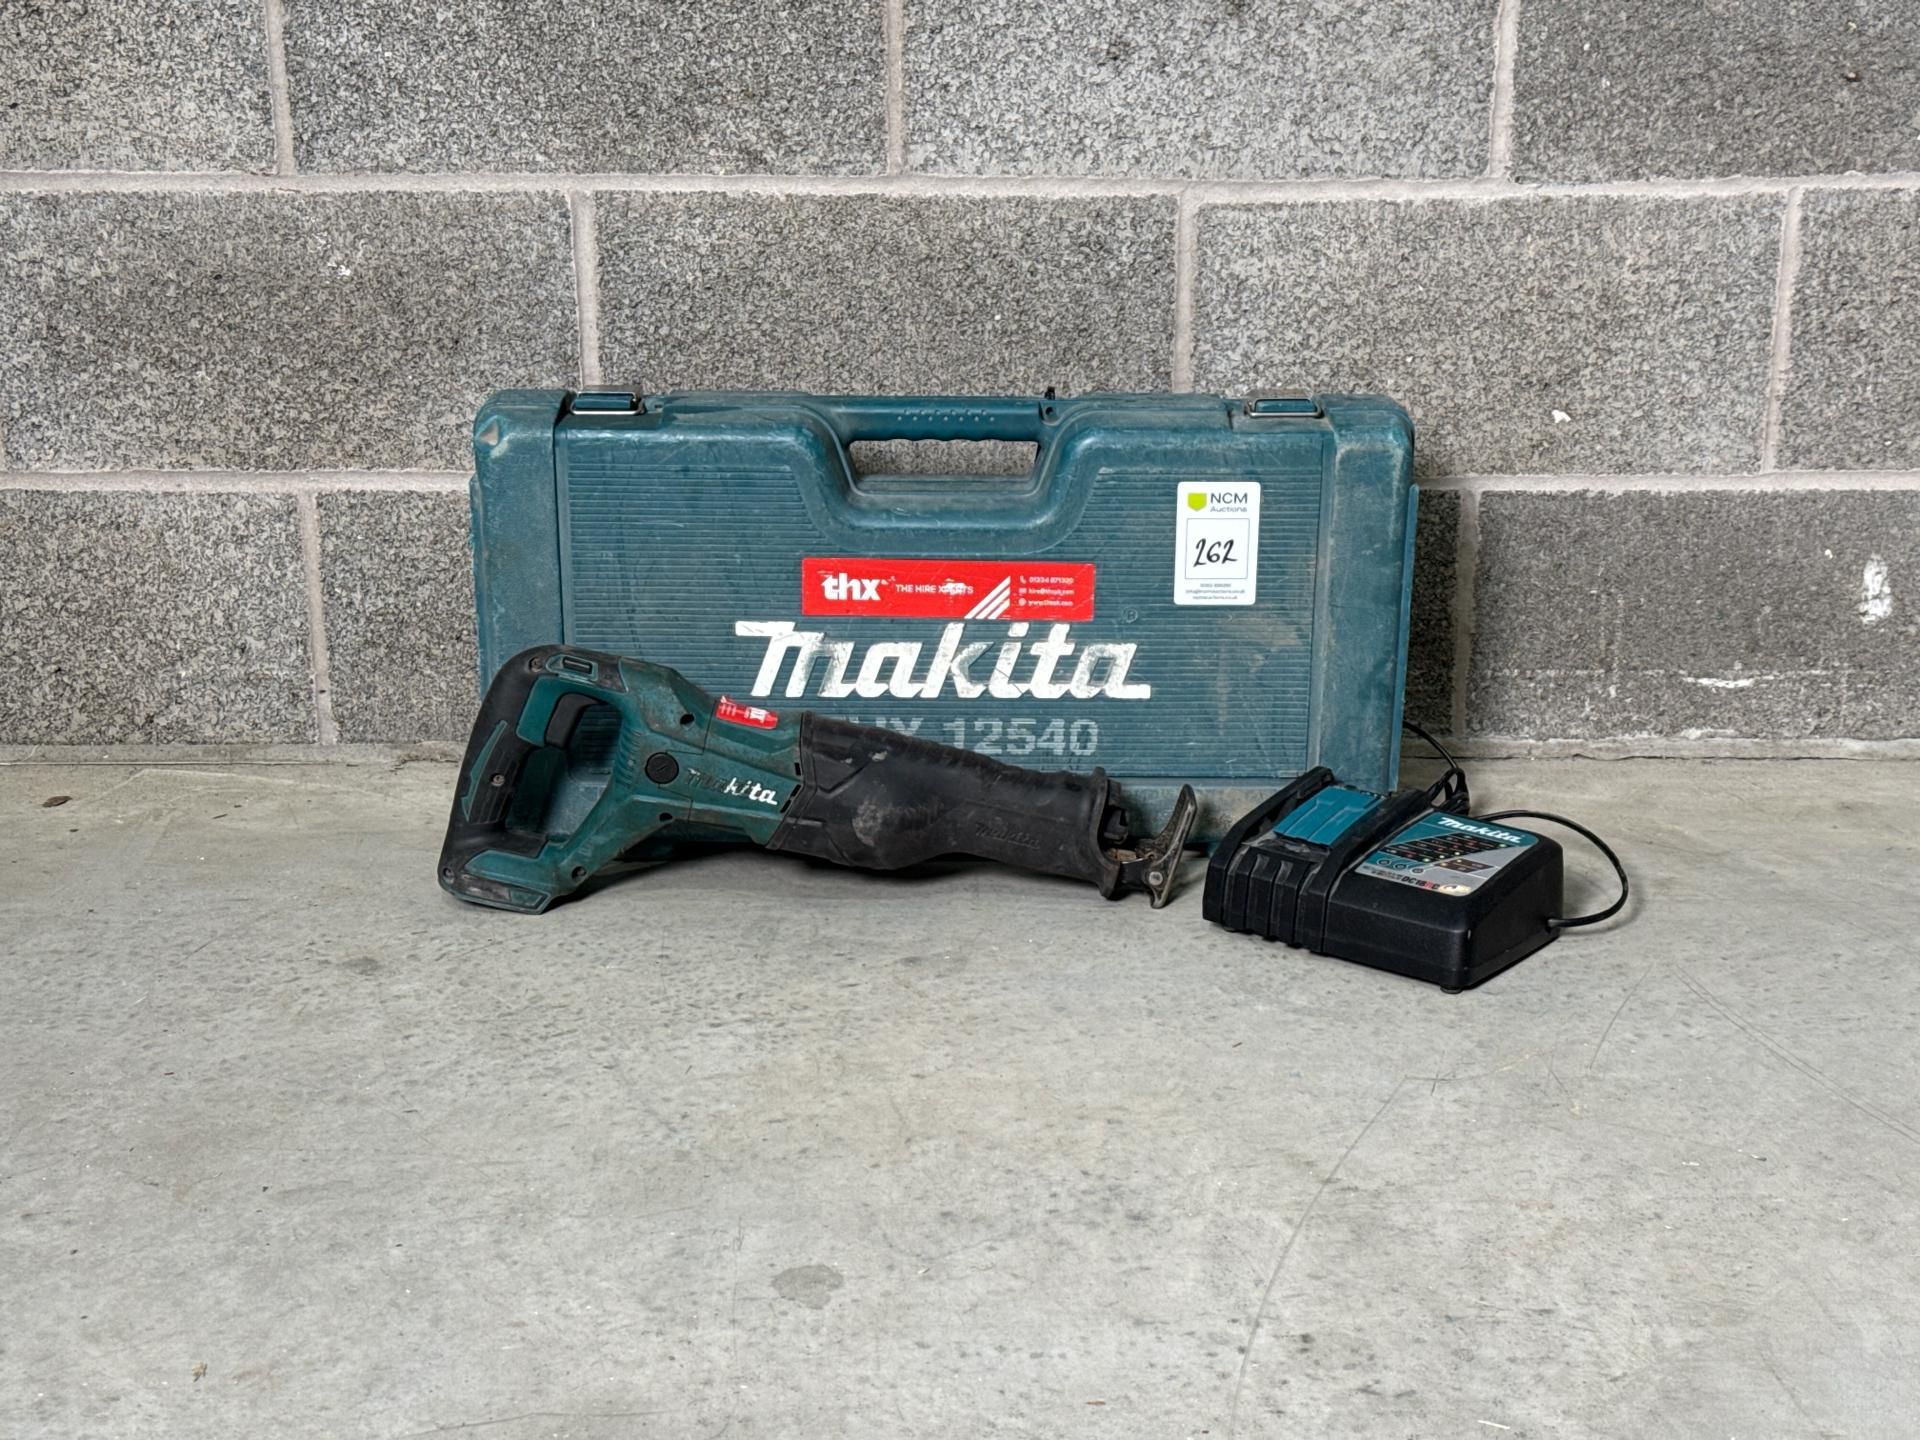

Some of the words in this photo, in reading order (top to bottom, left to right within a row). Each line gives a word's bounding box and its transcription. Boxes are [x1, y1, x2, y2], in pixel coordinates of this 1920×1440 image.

[1210, 492, 1248, 504] NCM
[1193, 538, 1238, 567] 262
[821, 572, 881, 601] thx
[896, 584, 913, 593] THE
[915, 584, 936, 593] HIRE
[938, 584, 974, 594] XTS
[735, 621, 1151, 698] Makita
[943, 718, 1099, 755] 12540
[1437, 816, 1520, 843] Makita
